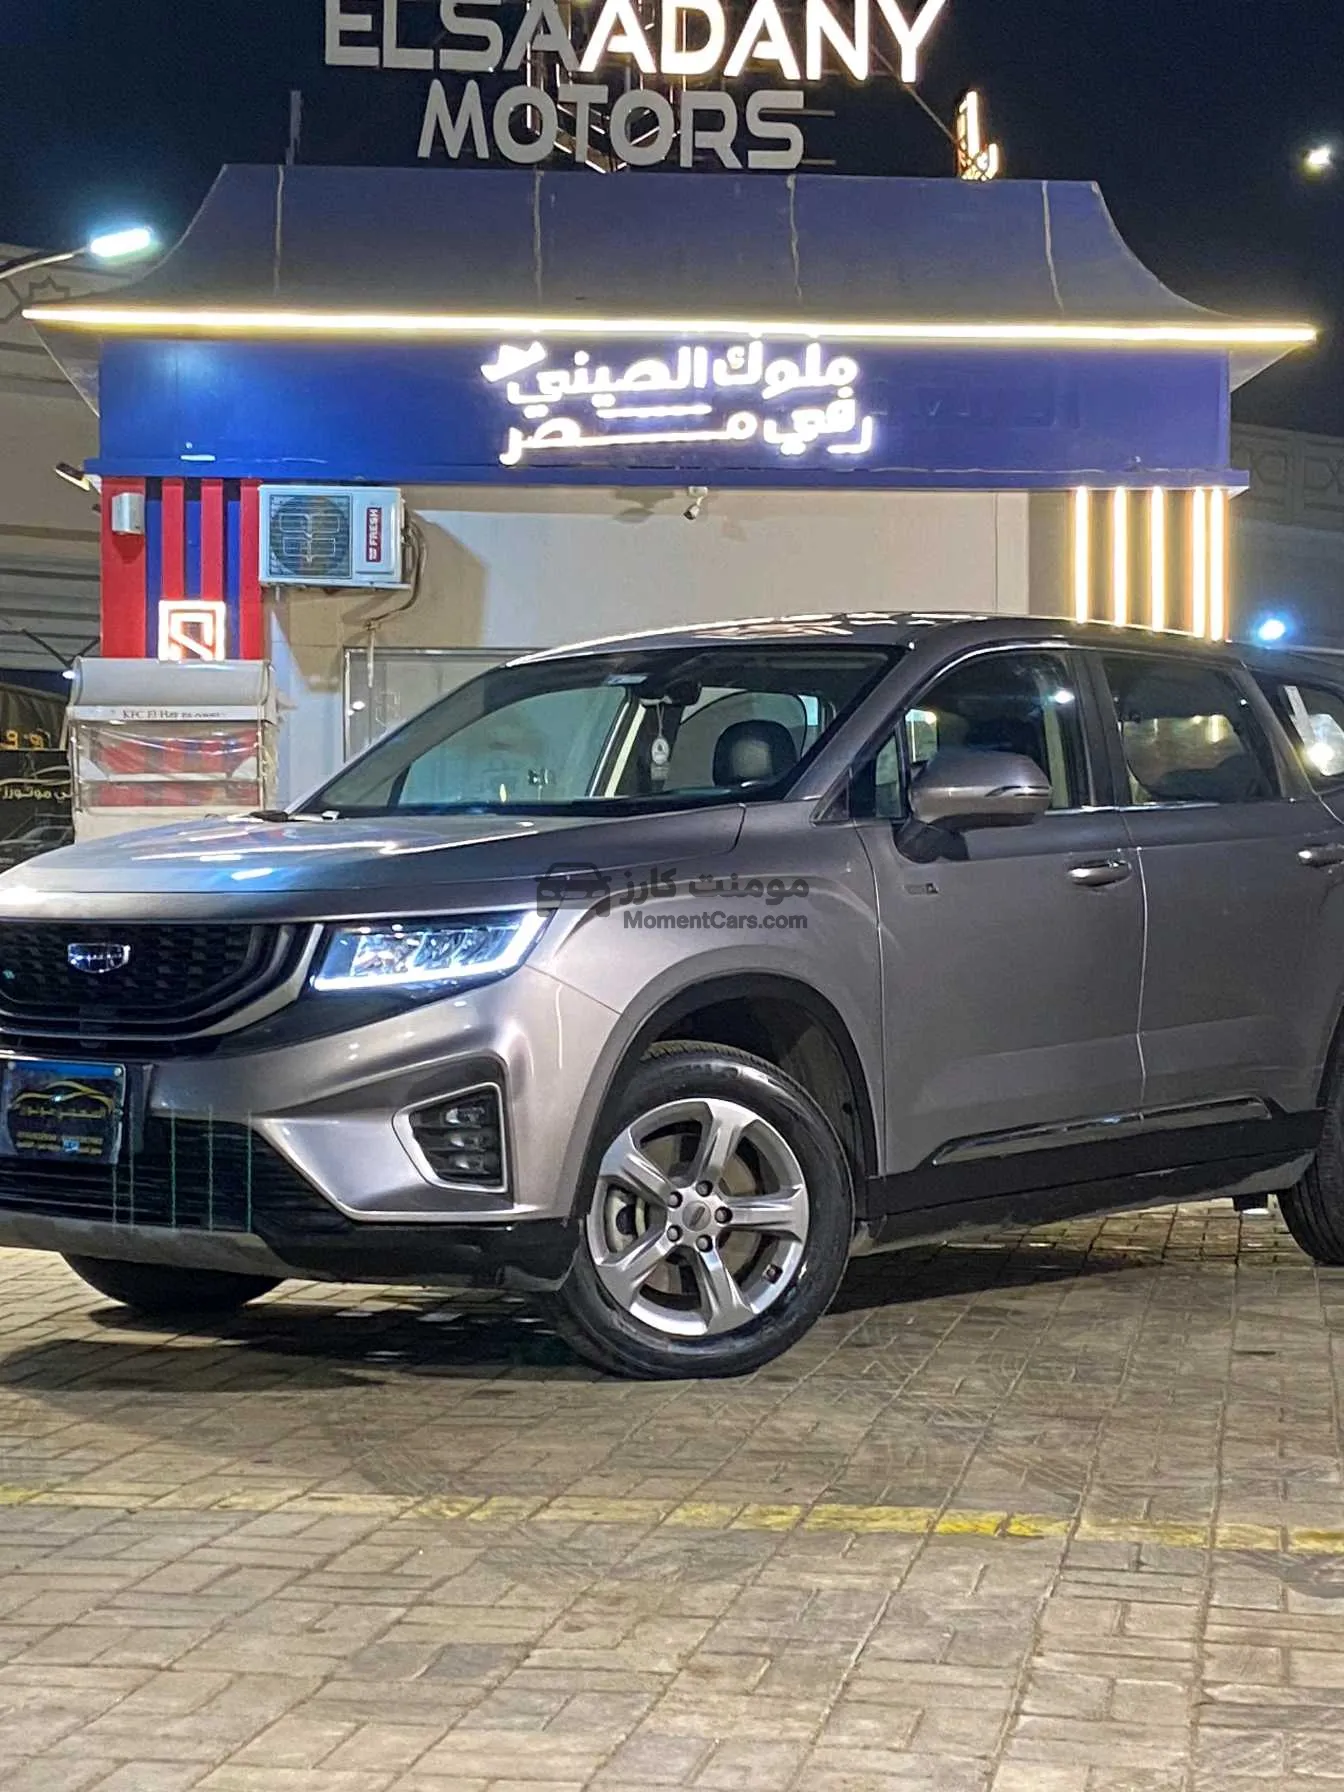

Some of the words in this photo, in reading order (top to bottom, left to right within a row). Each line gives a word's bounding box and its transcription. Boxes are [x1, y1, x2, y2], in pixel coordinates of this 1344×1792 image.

[324, 0, 944, 83] ELSAADANY
[417, 78, 805, 170] MOTORS
[507, 345, 708, 419] الصيني
[711, 340, 859, 400] ملوك
[498, 411, 758, 466] مصر
[368, 509, 378, 546] FRESH
